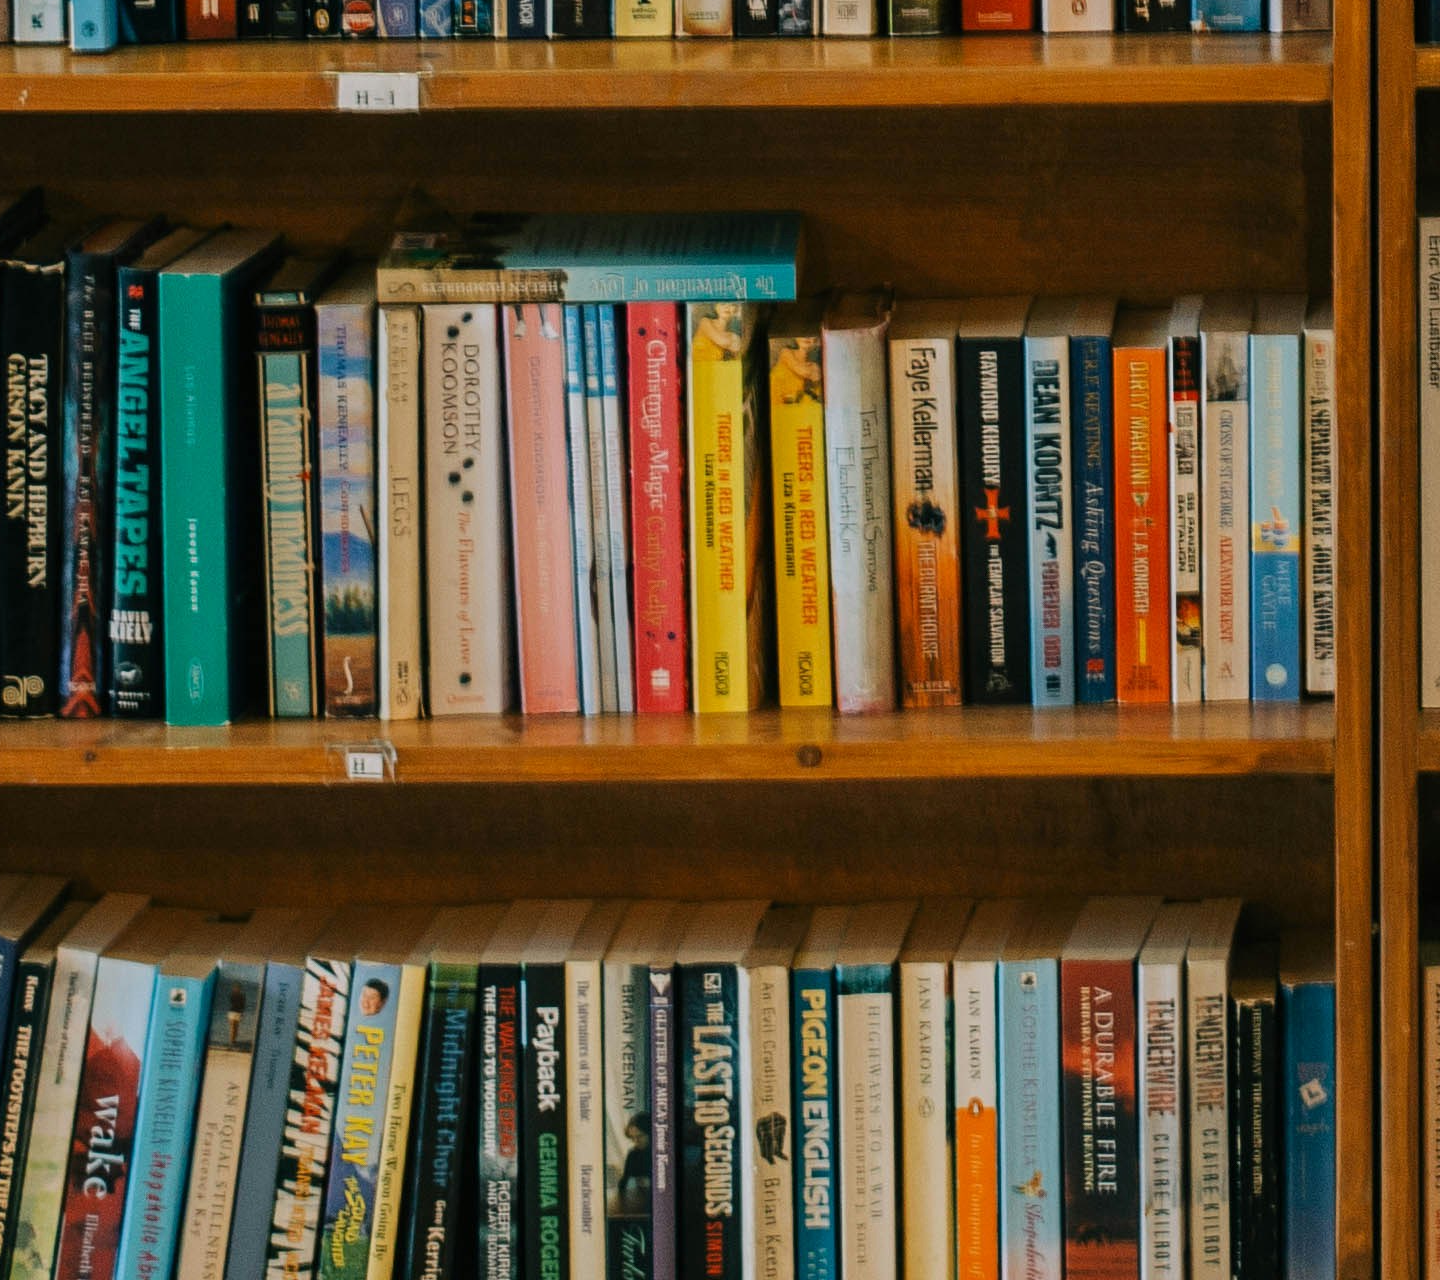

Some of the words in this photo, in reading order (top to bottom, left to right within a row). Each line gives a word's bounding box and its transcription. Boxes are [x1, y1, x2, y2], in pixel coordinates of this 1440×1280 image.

[1031, 359, 1063, 423] DEAN
[1033, 431, 1065, 529] KOONTZ
[534, 1006, 559, 1111] Payback
[802, 989, 827, 1095] PIGEON
[802, 1101, 831, 1229] ENGLISH
